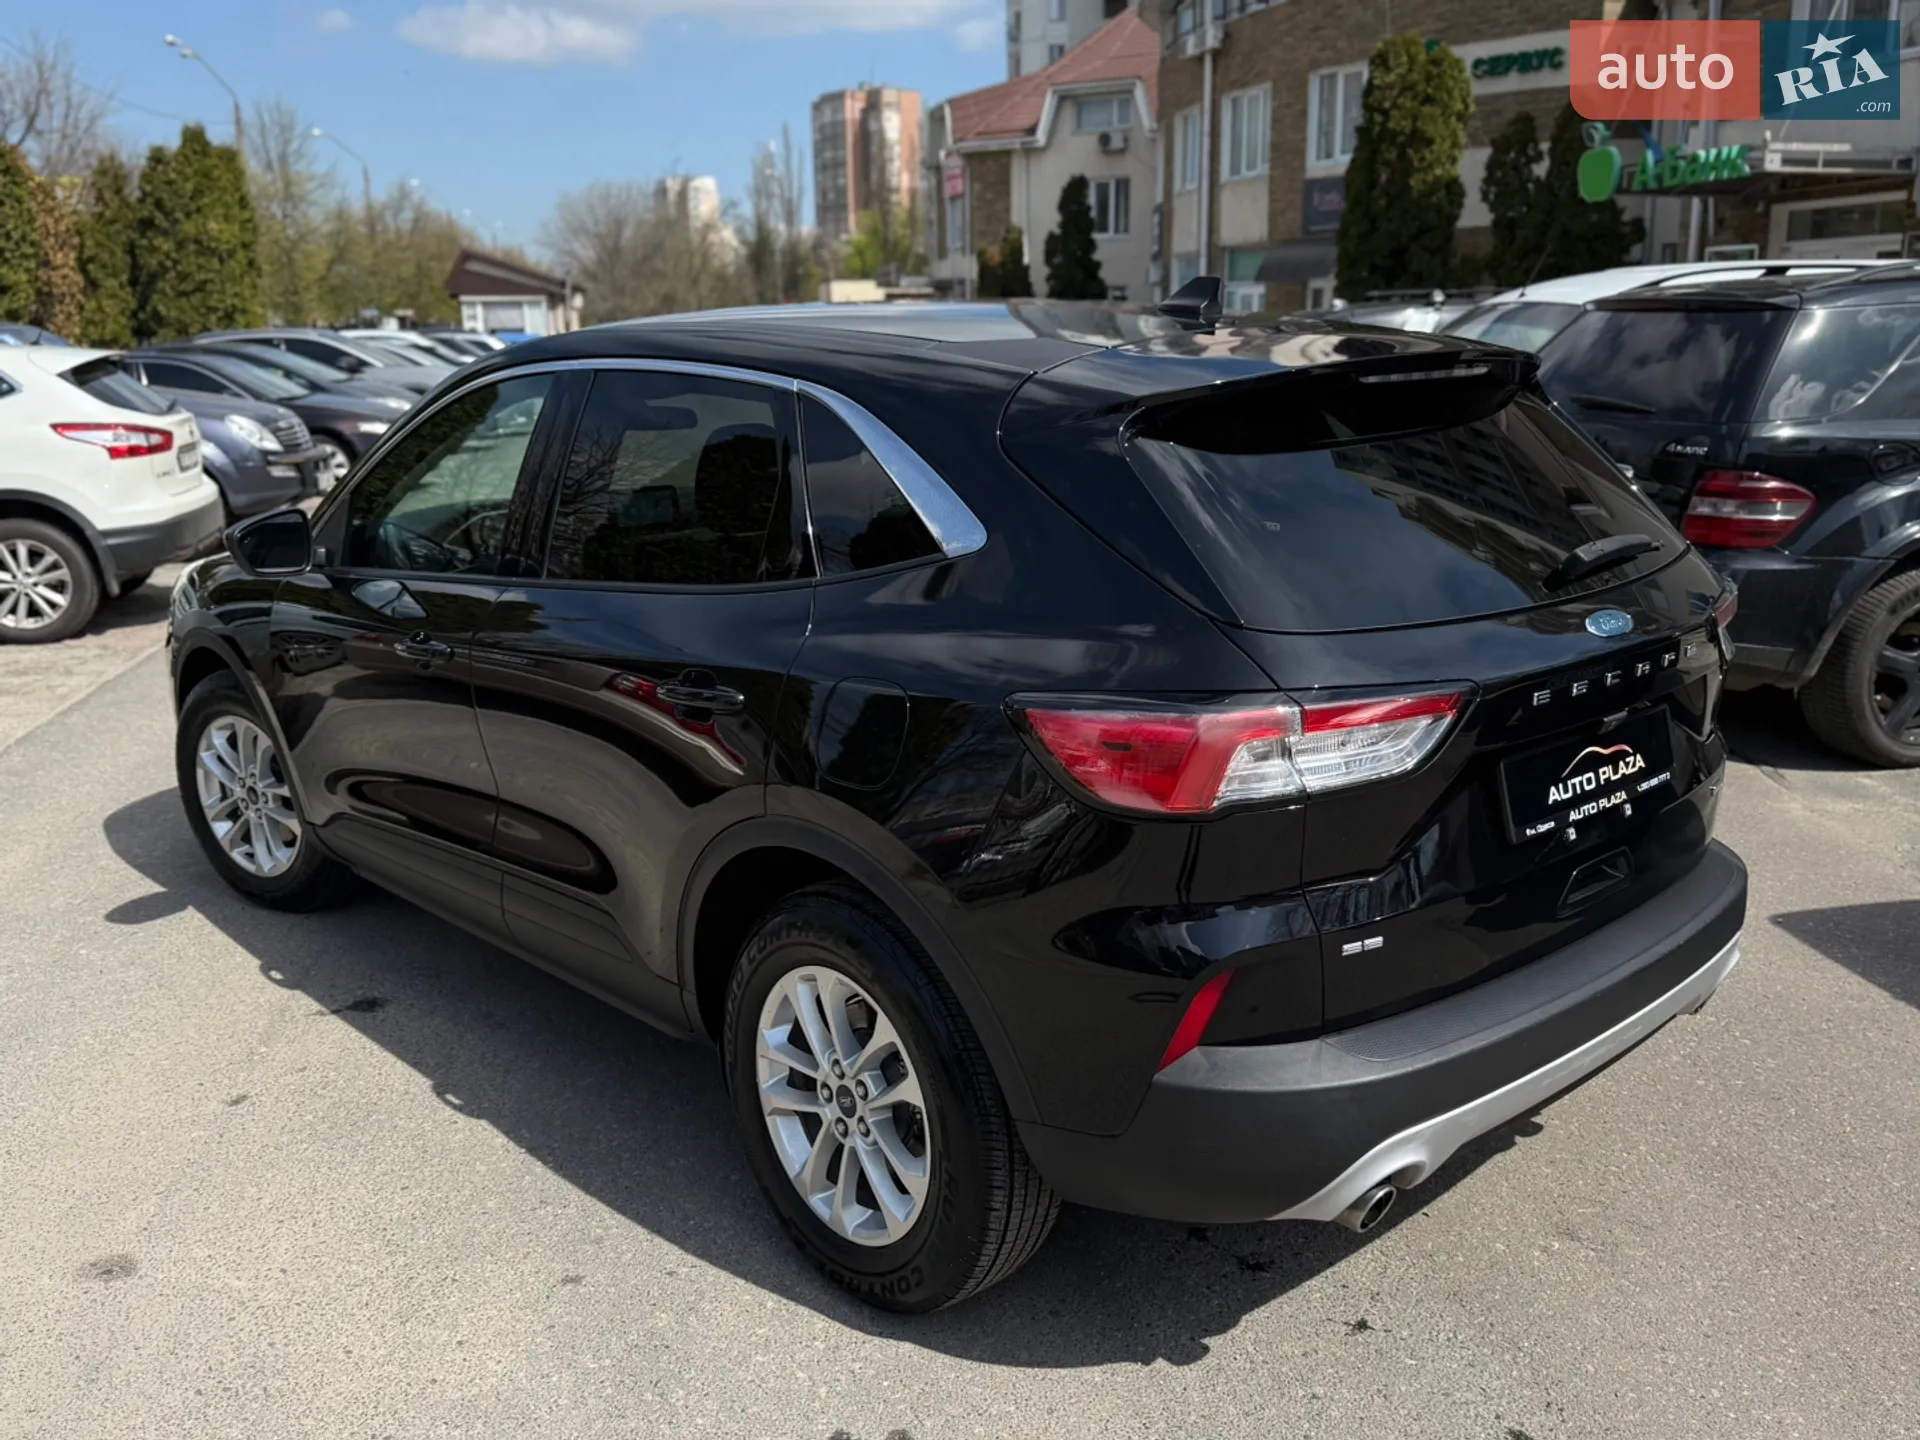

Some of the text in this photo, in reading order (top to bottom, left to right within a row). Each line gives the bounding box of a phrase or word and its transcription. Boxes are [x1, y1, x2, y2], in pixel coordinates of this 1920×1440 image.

[1532, 642, 1698, 706] ESCAPE
[1548, 771, 1597, 805] AUTO
[1598, 753, 1646, 785] PLAZA
[1568, 790, 1628, 822] AUTO PLAZA
